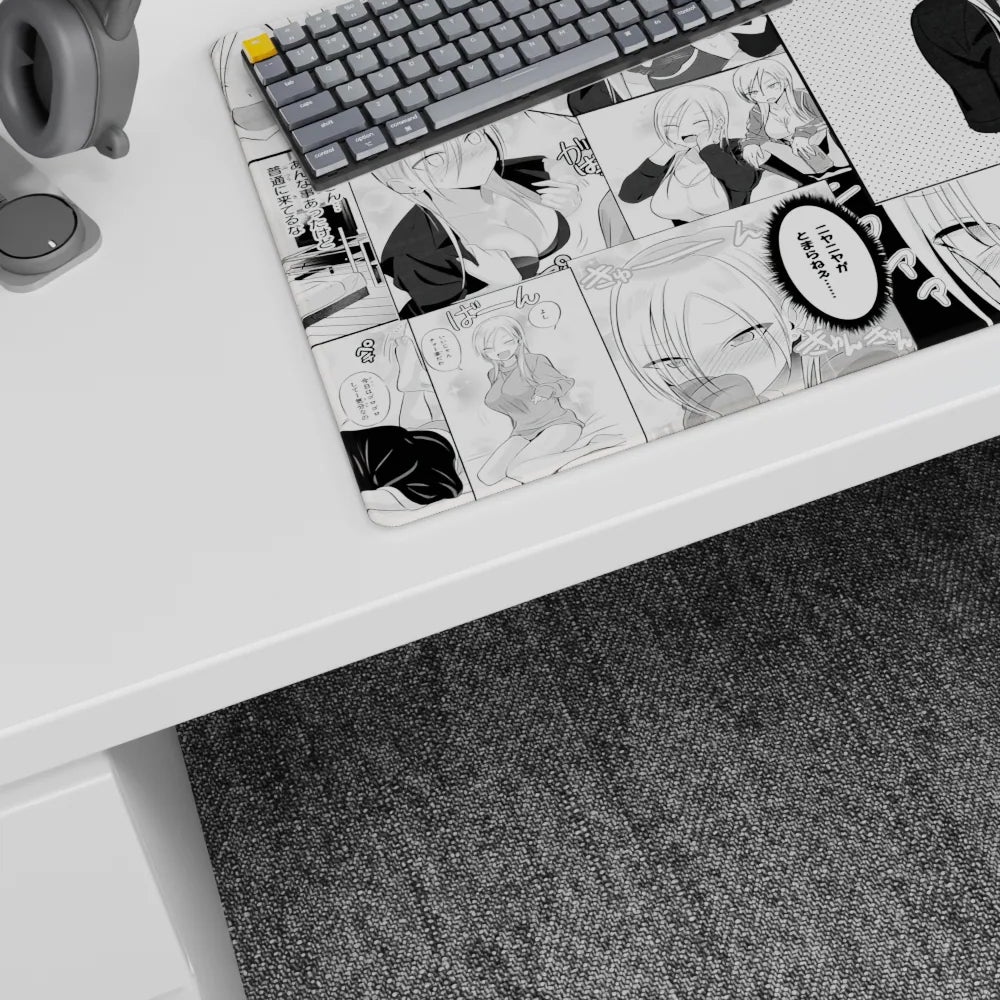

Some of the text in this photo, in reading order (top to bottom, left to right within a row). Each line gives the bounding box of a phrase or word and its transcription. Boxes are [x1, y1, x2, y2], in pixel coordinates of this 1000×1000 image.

[677, 5, 696, 15] control
[389, 113, 417, 129] command
[355, 132, 374, 143] option
[315, 147, 334, 158] control
[267, 166, 303, 236] 普通に来てるな
[814, 223, 848, 275] ニヤニヤが
[446, 285, 541, 331] ばーん
